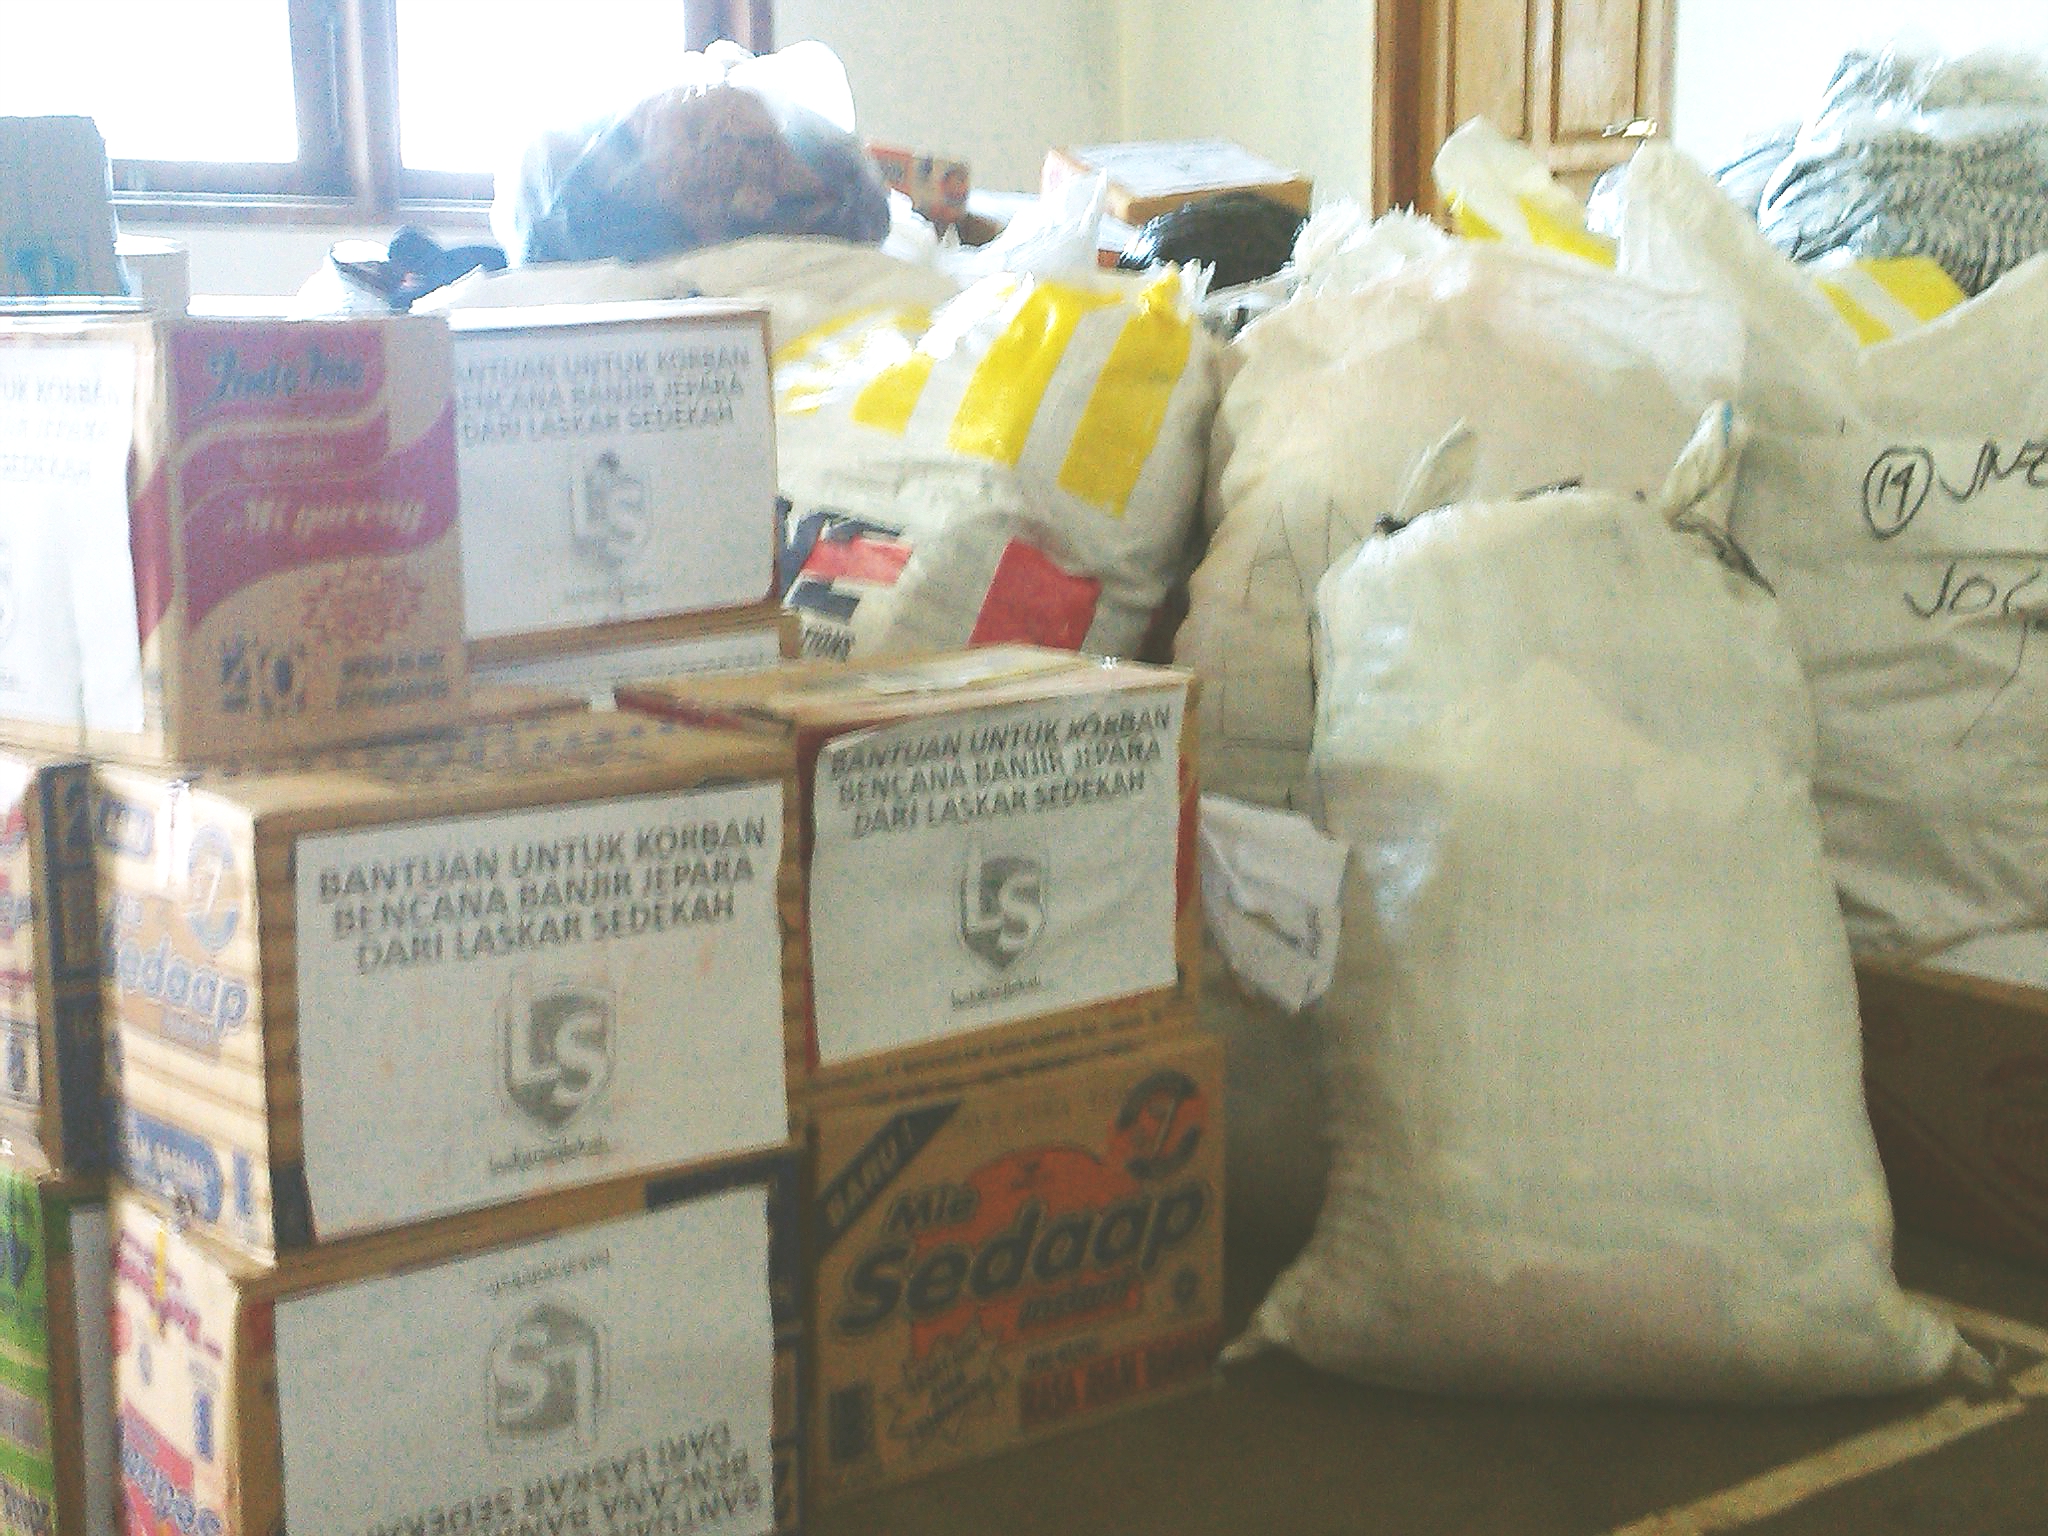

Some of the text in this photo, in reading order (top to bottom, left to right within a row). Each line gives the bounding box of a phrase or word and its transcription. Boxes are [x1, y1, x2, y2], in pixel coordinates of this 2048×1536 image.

[629, 398, 734, 429] SEDEKAH
[831, 704, 1171, 779] BANTUAN UNTUK KORBAN
[839, 736, 1161, 809] BENCANA BANJIR JEPARA
[854, 769, 1145, 839] DARI LASKAR SEDEKAH
[318, 816, 765, 898] BANTUAN UNTUK KORBAN
[333, 856, 754, 941] BENCANA BANJIR JEPARA
[357, 889, 735, 976] DARI LASKAR SEDEKAH
[835, 1179, 1211, 1335] Sedaap
